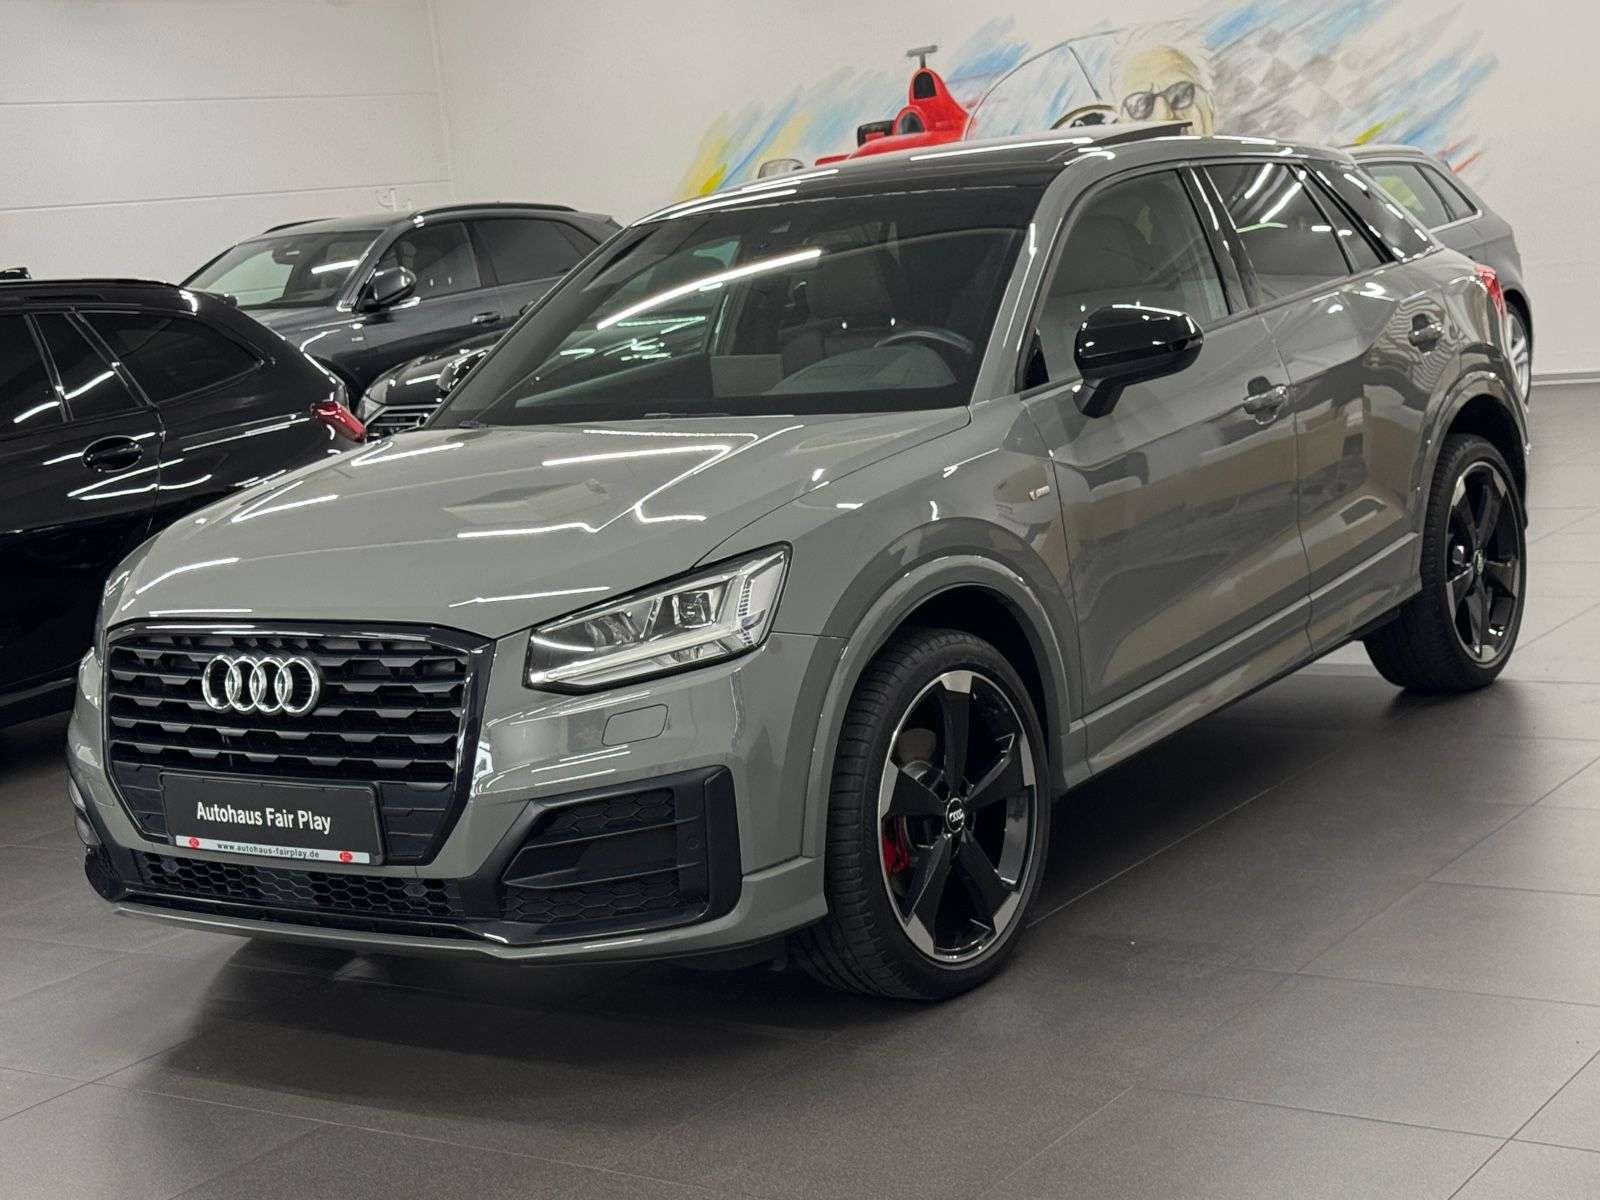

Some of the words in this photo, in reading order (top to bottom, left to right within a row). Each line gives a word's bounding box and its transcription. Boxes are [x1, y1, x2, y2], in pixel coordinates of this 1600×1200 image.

[197, 802, 263, 826] Autohaus
[265, 807, 294, 829] Fair
[298, 810, 331, 835] Play
[217, 843, 320, 859] www.autohaus-fairplay.de
